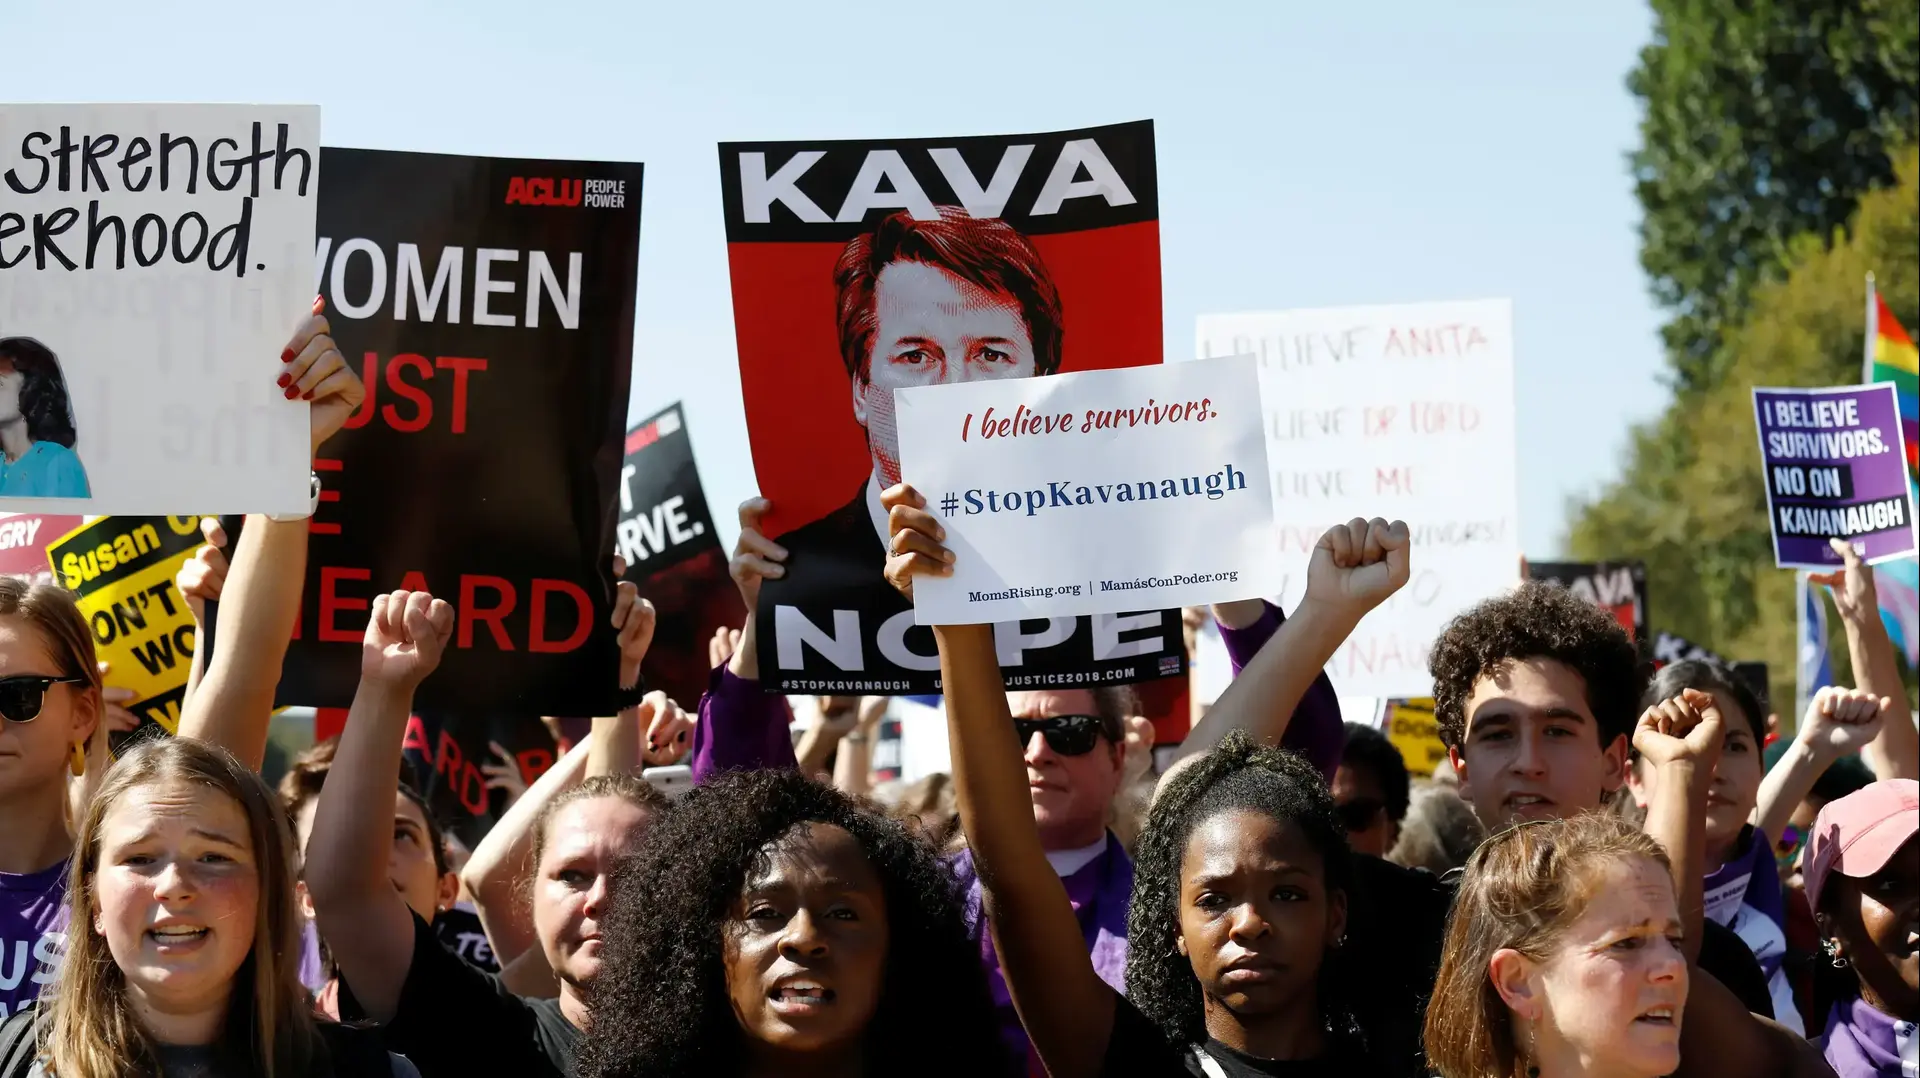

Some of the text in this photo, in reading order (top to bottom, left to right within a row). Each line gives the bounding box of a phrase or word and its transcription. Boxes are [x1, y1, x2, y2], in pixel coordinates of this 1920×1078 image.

[505, 177, 582, 207] ACLU
[585, 179, 626, 194] PEOPLE
[738, 138, 1138, 223] KAVA
[584, 194, 626, 208] POWER
[1383, 323, 1489, 357] ANITA
[962, 397, 1218, 442] I believe survivors.
[1764, 399, 1860, 428] I BELIEVE
[1768, 428, 1889, 460] SURVIVORS.
[940, 464, 1248, 518] #StopKavanaugh
[1774, 467, 1841, 497] NO ON
[616, 494, 704, 568] RVE.
[1780, 498, 1904, 536] KAVANAUGH
[61, 523, 162, 590] Susan
[968, 569, 1239, 603] MomsRising.org MamásConPoder.org
[291, 566, 595, 654] ERD
[781, 680, 911, 691] #STOPKAVANAUGH
